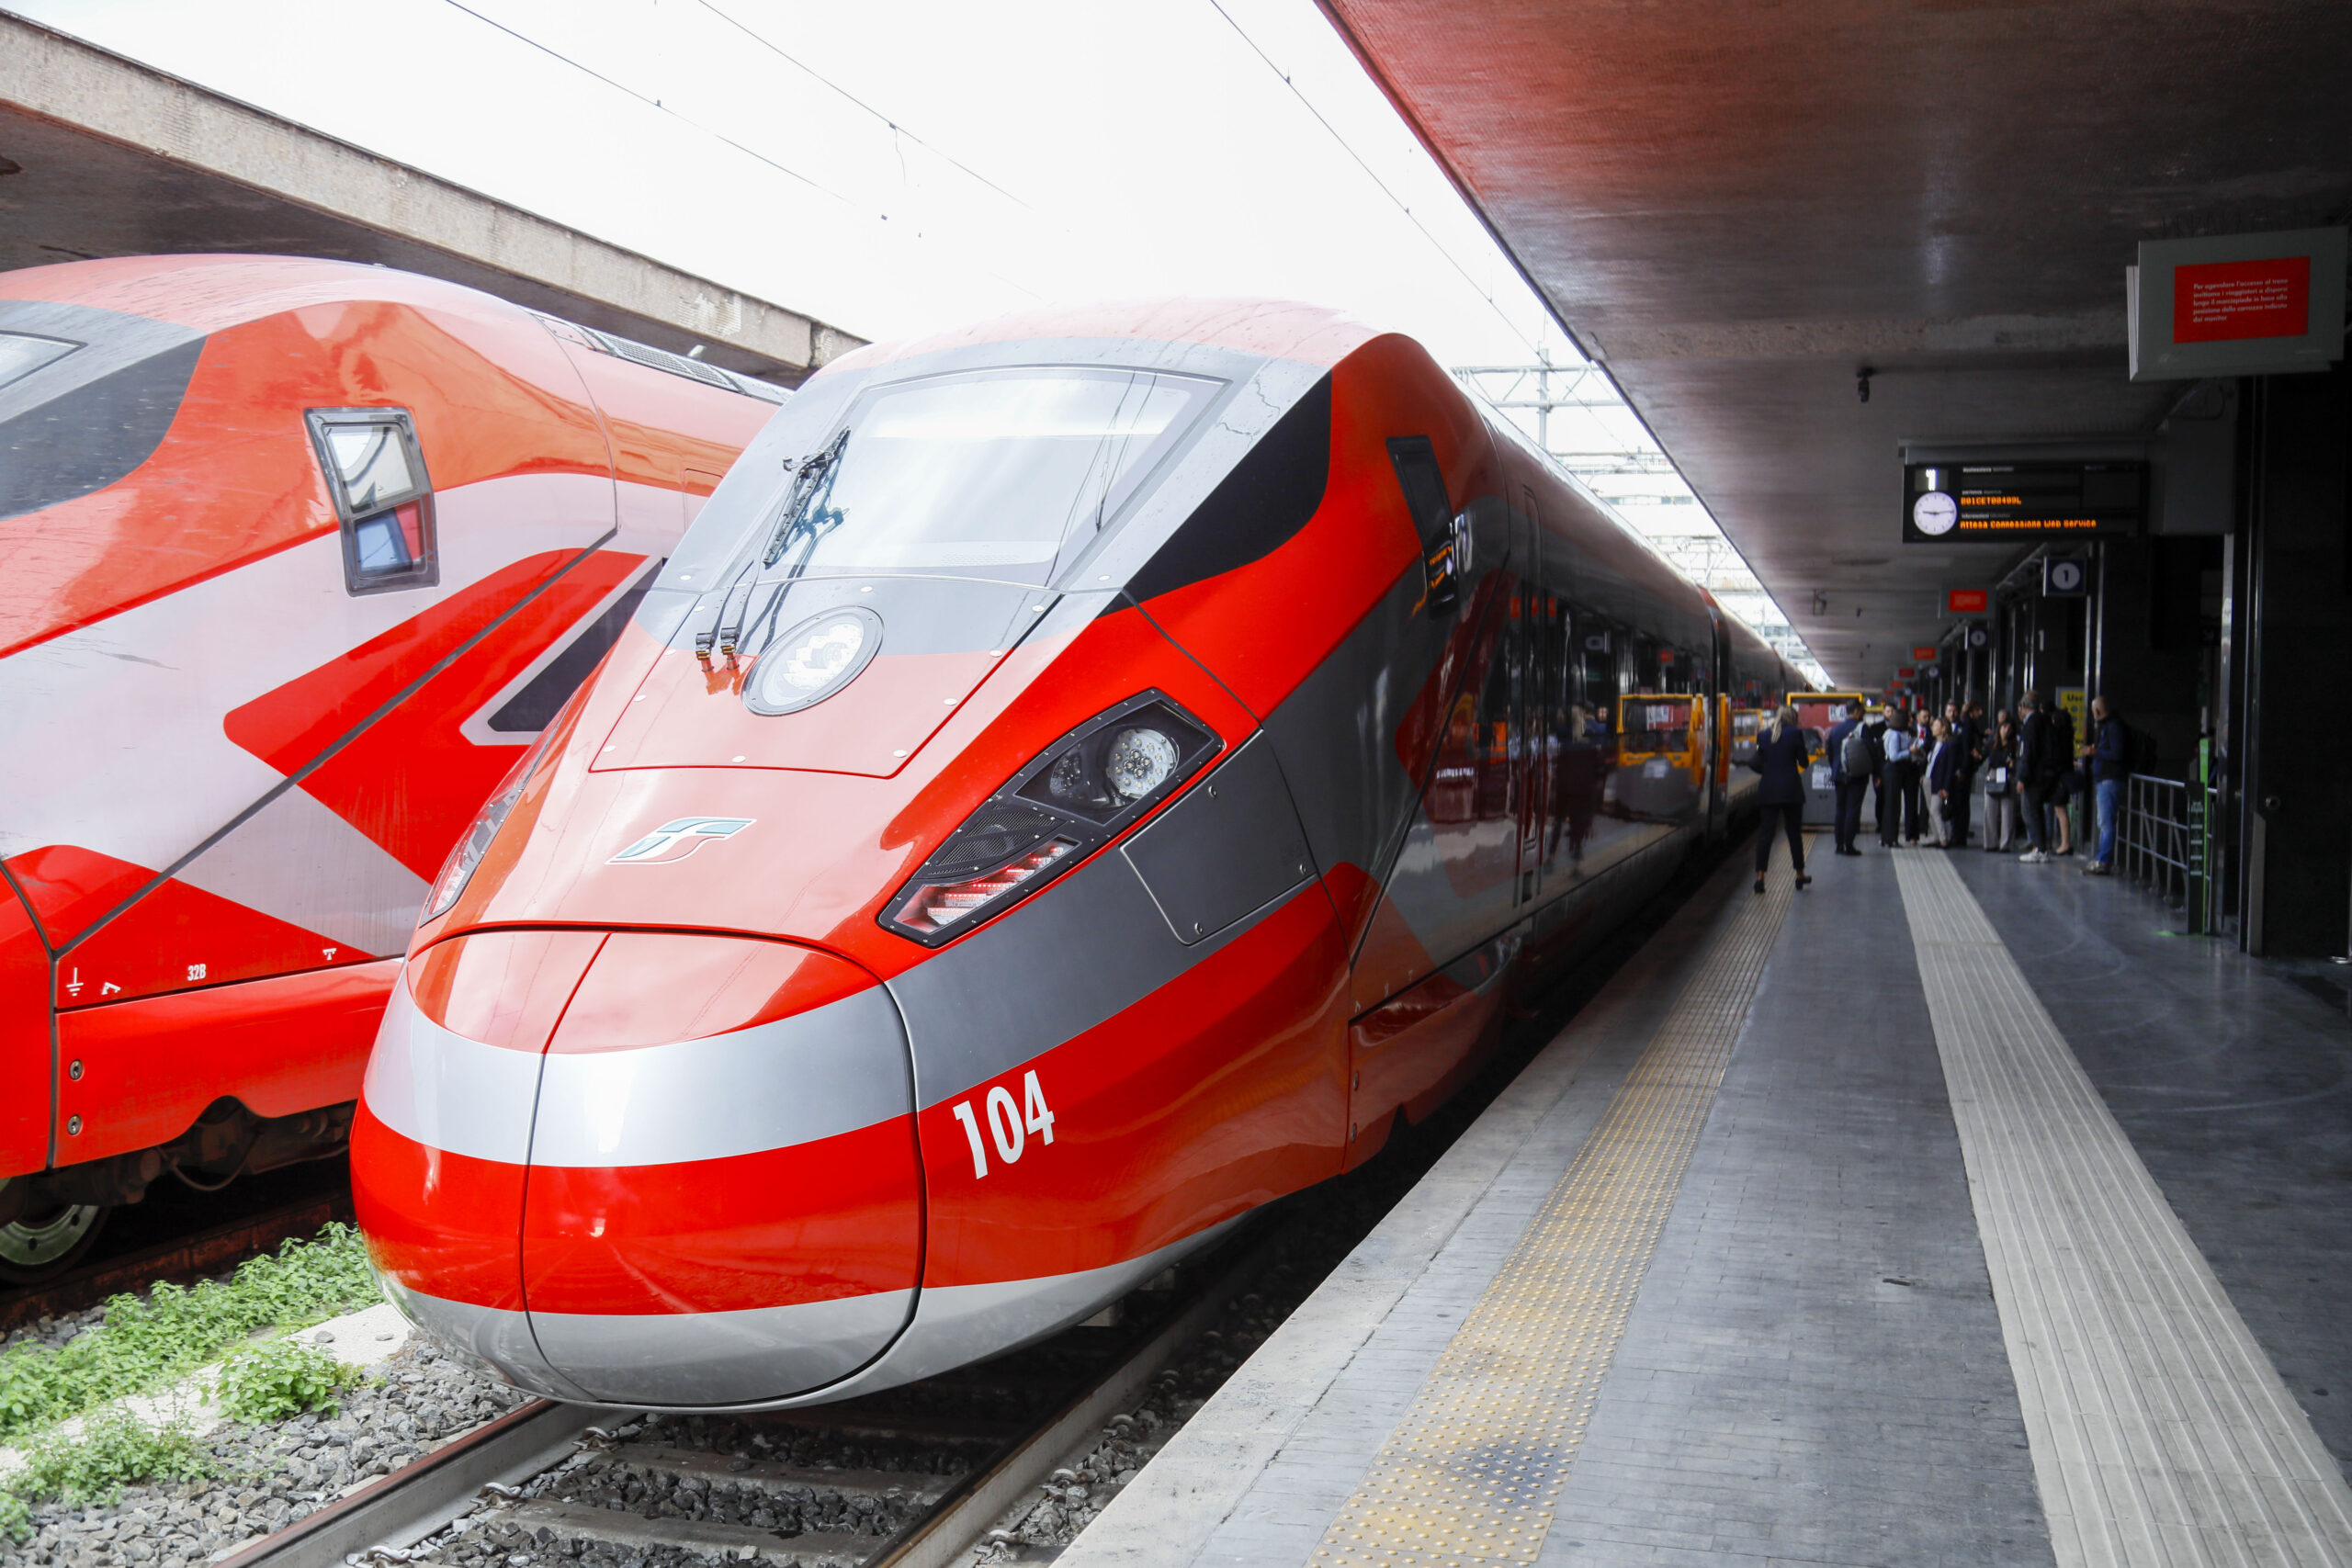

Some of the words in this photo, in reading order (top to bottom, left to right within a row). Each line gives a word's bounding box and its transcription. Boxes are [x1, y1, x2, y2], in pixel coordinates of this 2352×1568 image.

[2193, 282, 2203, 290] Per
[1926, 468, 1938, 491] 1
[2063, 570, 2069, 582] 1
[187, 964, 207, 981] 32B
[953, 1069, 1055, 1179] 104
